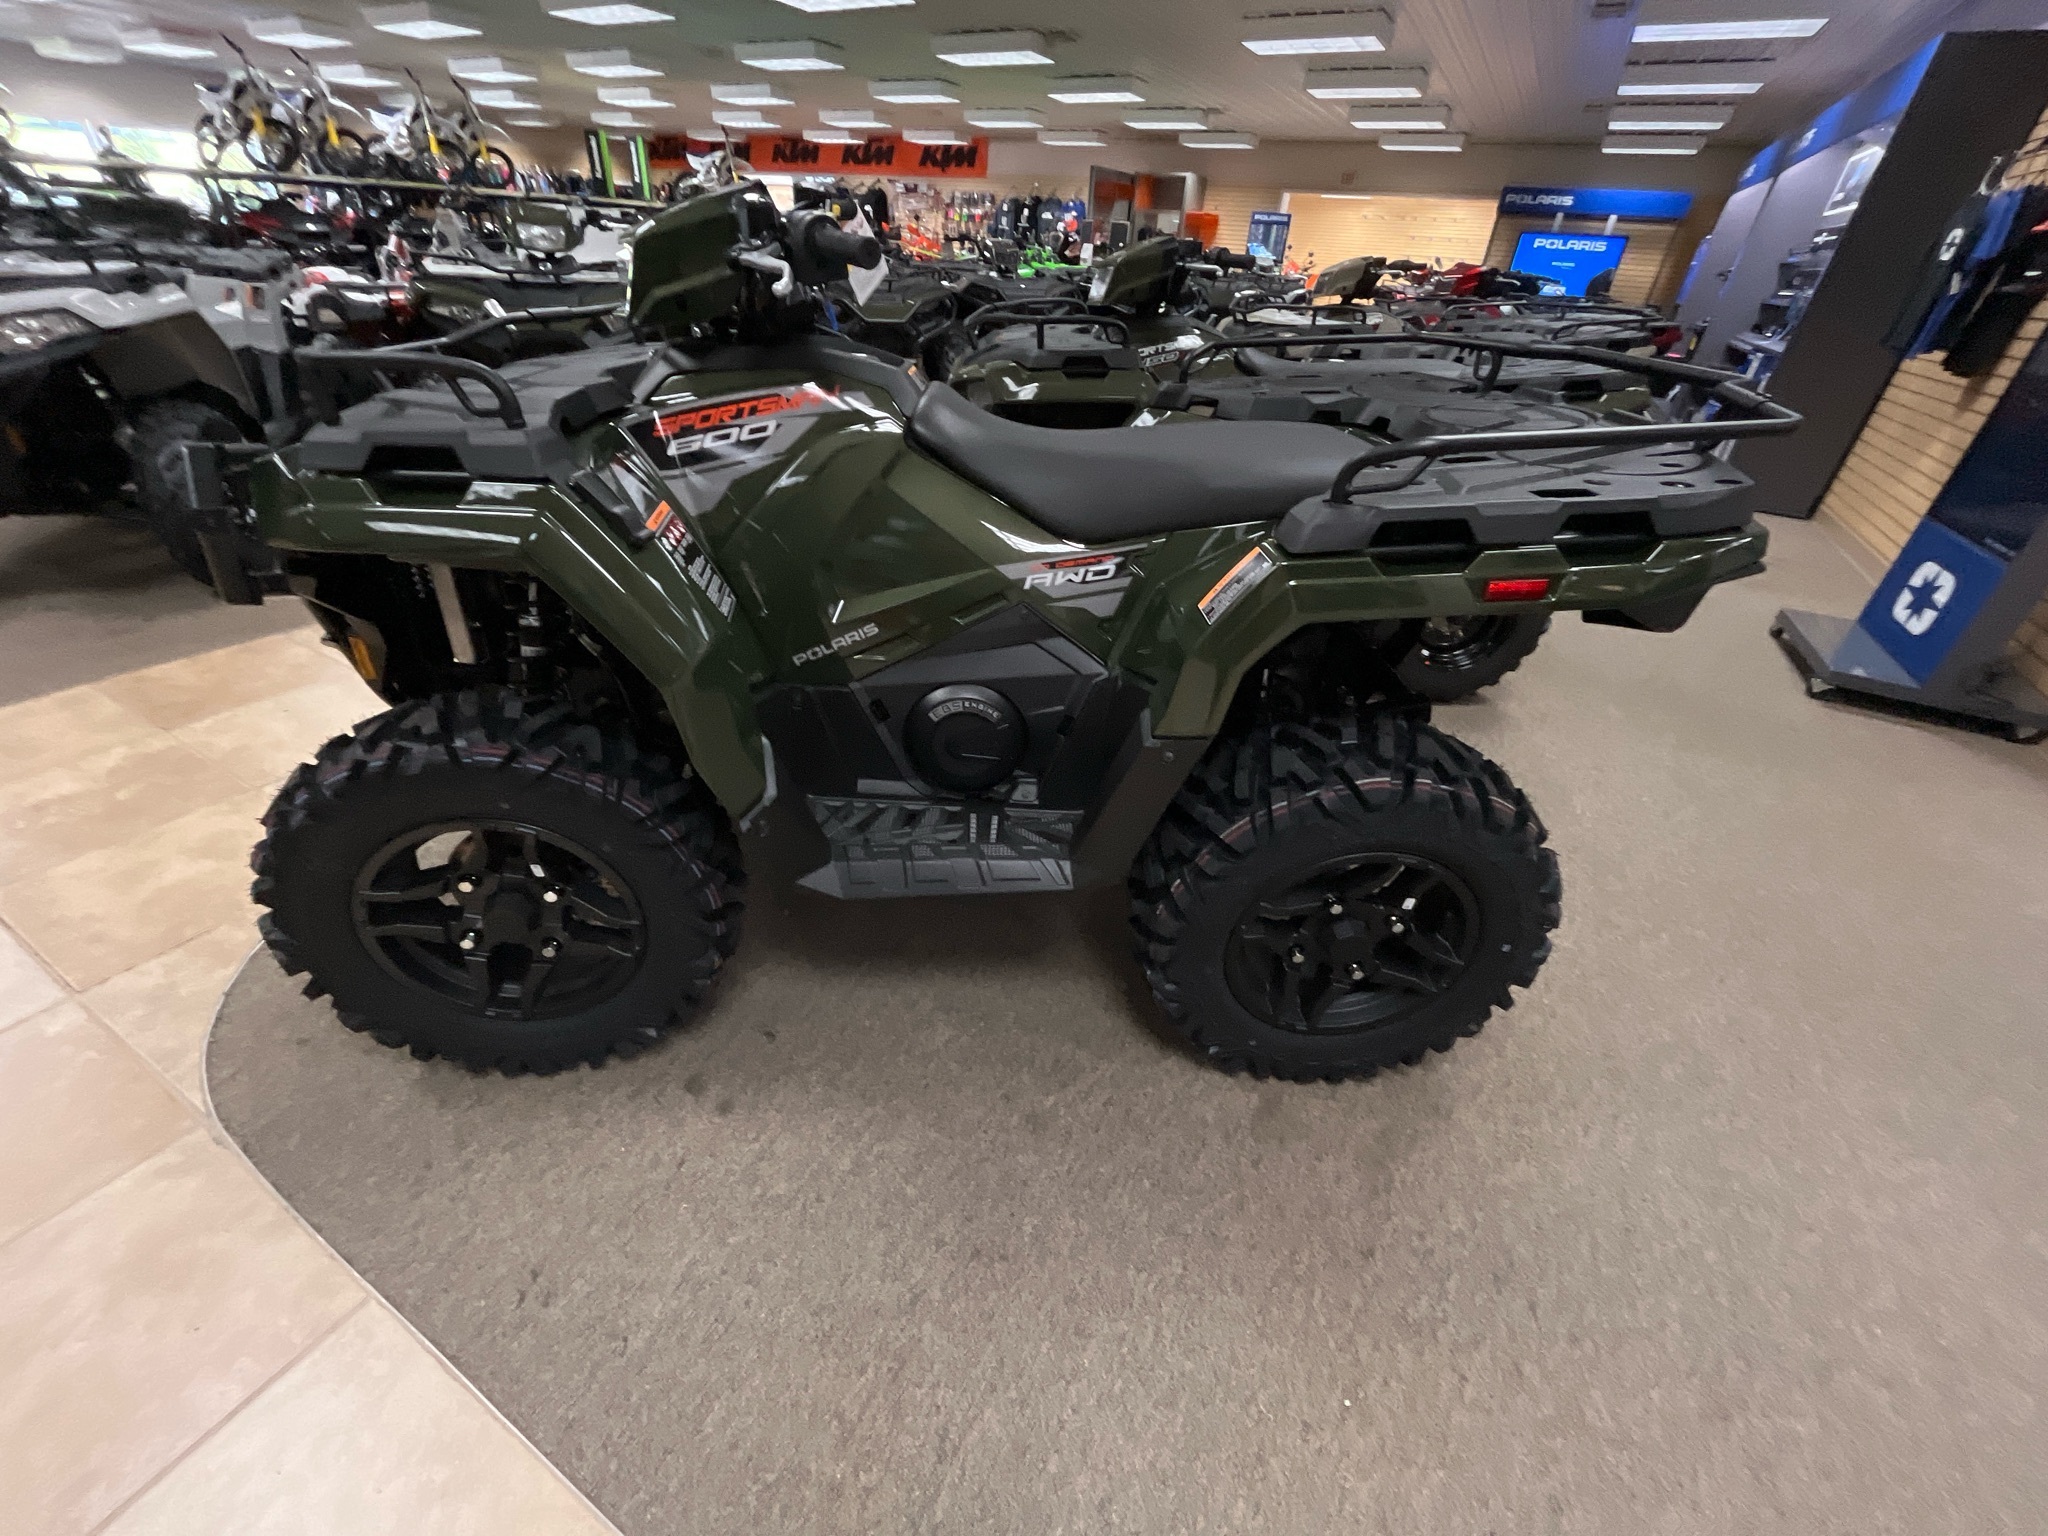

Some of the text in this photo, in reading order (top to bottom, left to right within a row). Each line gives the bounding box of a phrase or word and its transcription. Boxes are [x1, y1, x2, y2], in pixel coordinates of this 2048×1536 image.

[772, 137, 819, 163] KTM
[841, 137, 895, 165] KTM
[919, 144, 978, 172] KTM
[1505, 194, 1575, 206] POLARIS
[1533, 238, 1608, 252] POLARIS
[667, 419, 779, 456] 600
[1023, 564, 1117, 590] AWD
[792, 622, 880, 667] POLARIS
